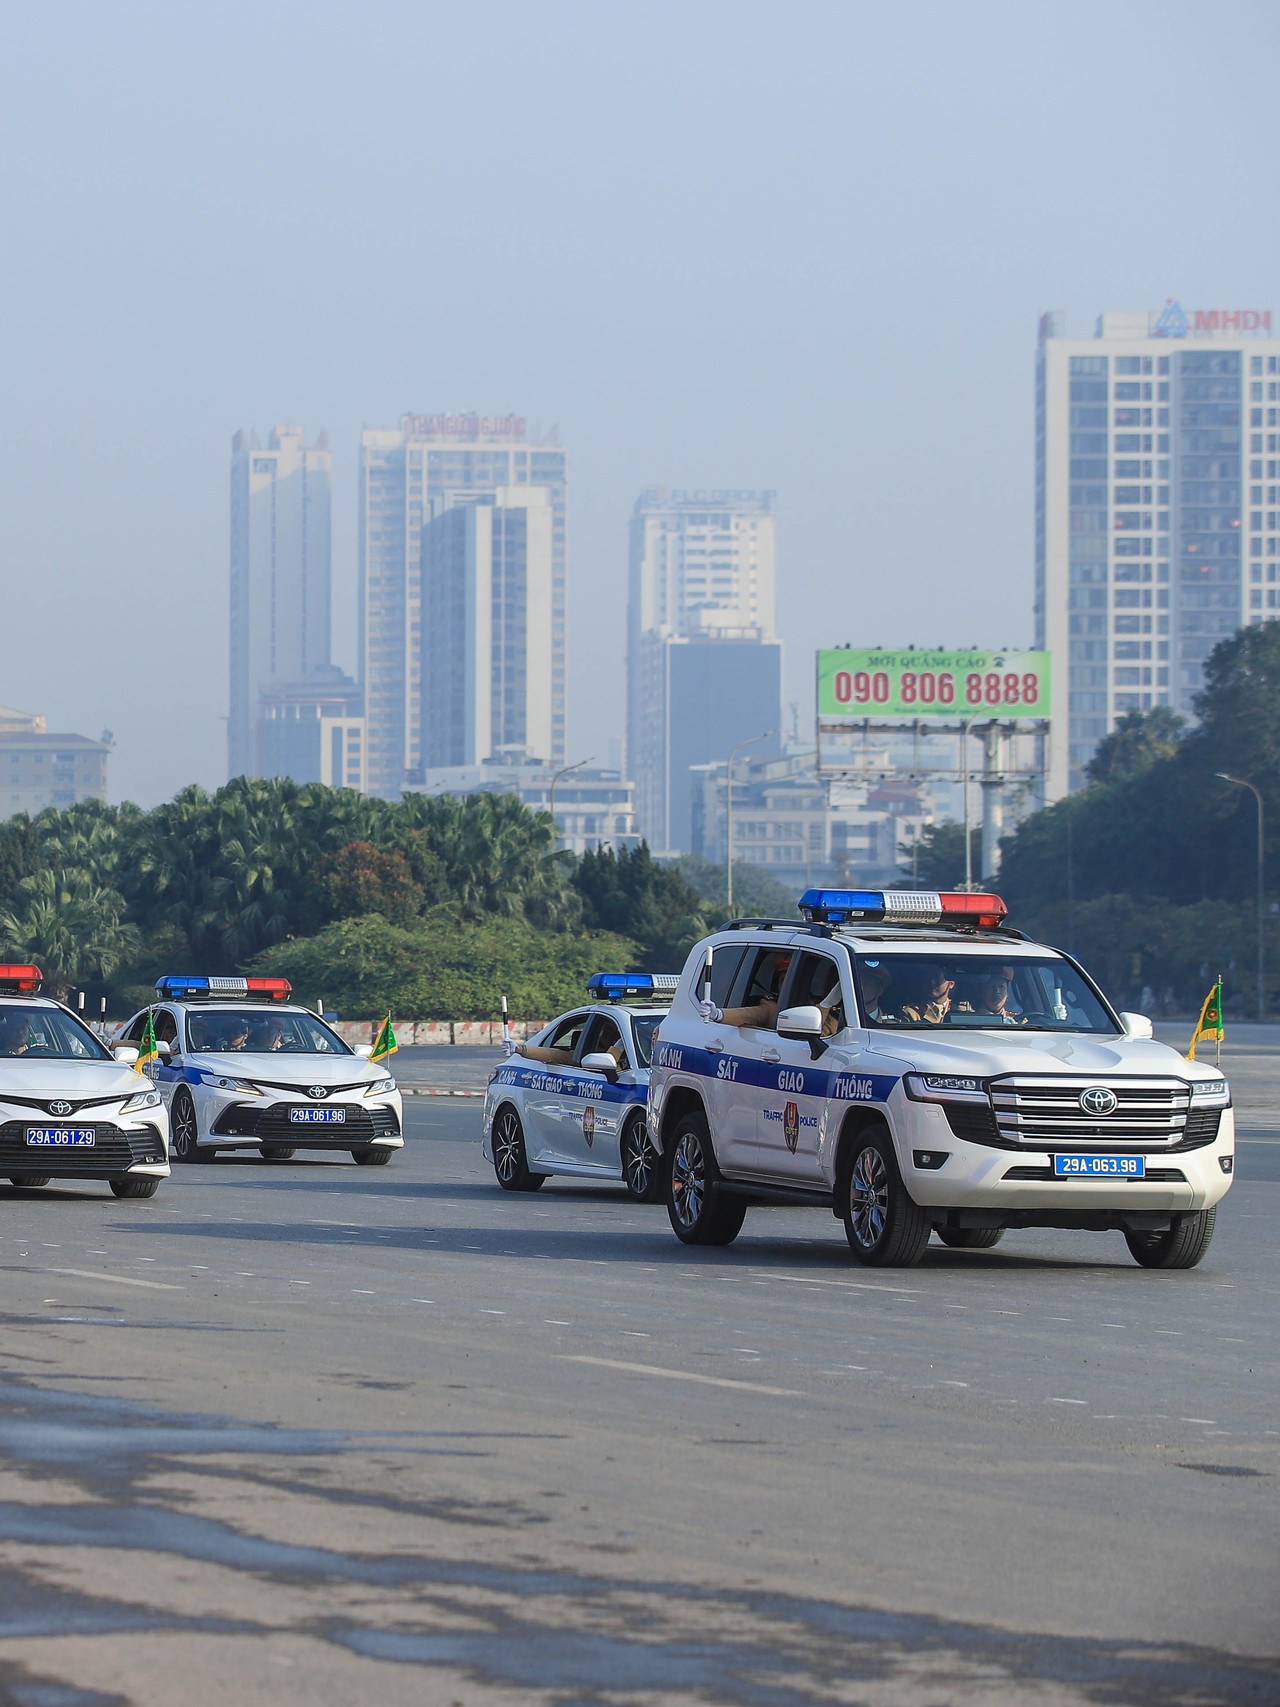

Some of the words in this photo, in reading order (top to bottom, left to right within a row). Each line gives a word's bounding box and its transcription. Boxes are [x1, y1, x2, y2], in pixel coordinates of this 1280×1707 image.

[1195, 310, 1271, 331] MHDI
[835, 672, 889, 704] 090
[901, 672, 954, 704] 806
[966, 673, 1038, 704] 8888
[717, 1056, 739, 1080] SÁT
[778, 1070, 804, 1092] GIAO
[835, 1074, 873, 1099] THÔNG
[546, 1079, 563, 1093] GIAO
[292, 1110, 344, 1121] 29A-061.96
[763, 1110, 783, 1122] TRAFFIC
[800, 1116, 818, 1127] POLICE
[29, 1130, 93, 1145] 29A-061.29
[1063, 1158, 1137, 1173] 29A-063.98
